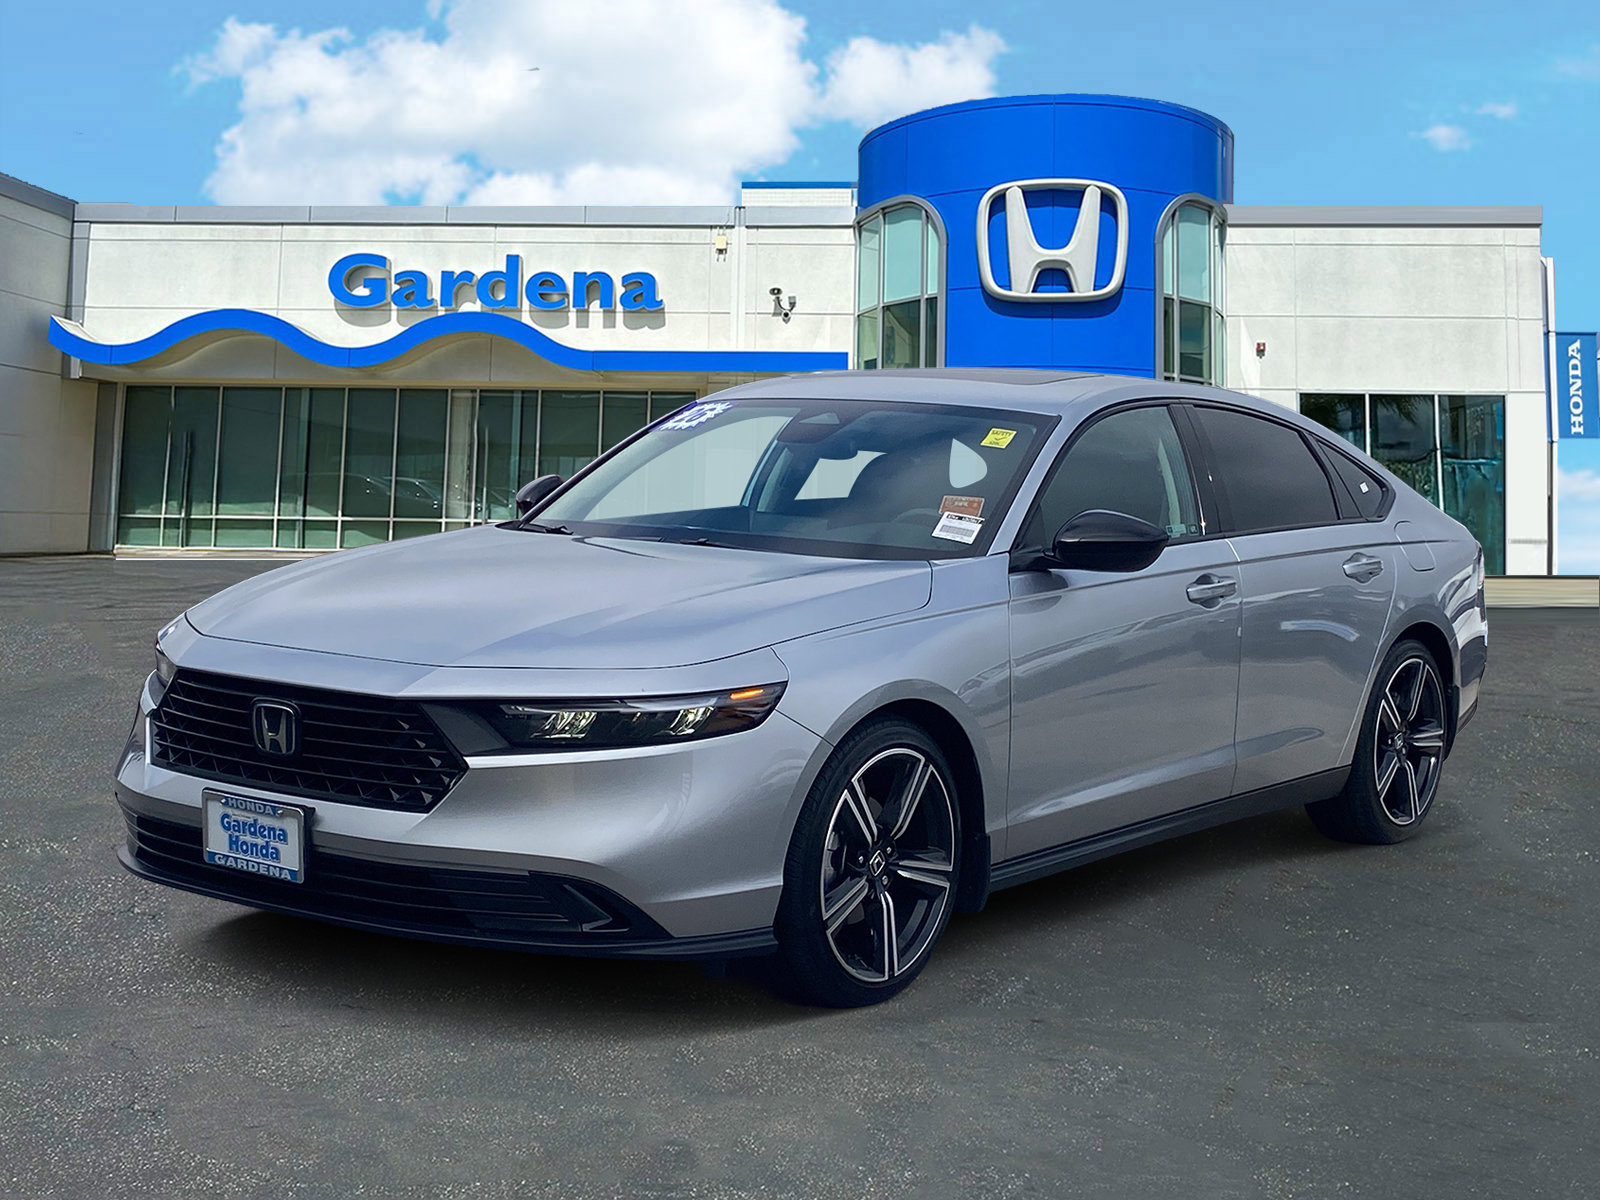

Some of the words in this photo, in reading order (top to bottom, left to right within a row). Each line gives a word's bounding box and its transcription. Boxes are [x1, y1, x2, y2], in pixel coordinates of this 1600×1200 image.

[327, 252, 663, 309] Gardena
[1567, 338, 1585, 435] HONDA
[226, 797, 275, 816] HONDA
[220, 812, 288, 843] Gardena
[227, 833, 281, 861] Honda
[213, 854, 293, 881] GARDENA
